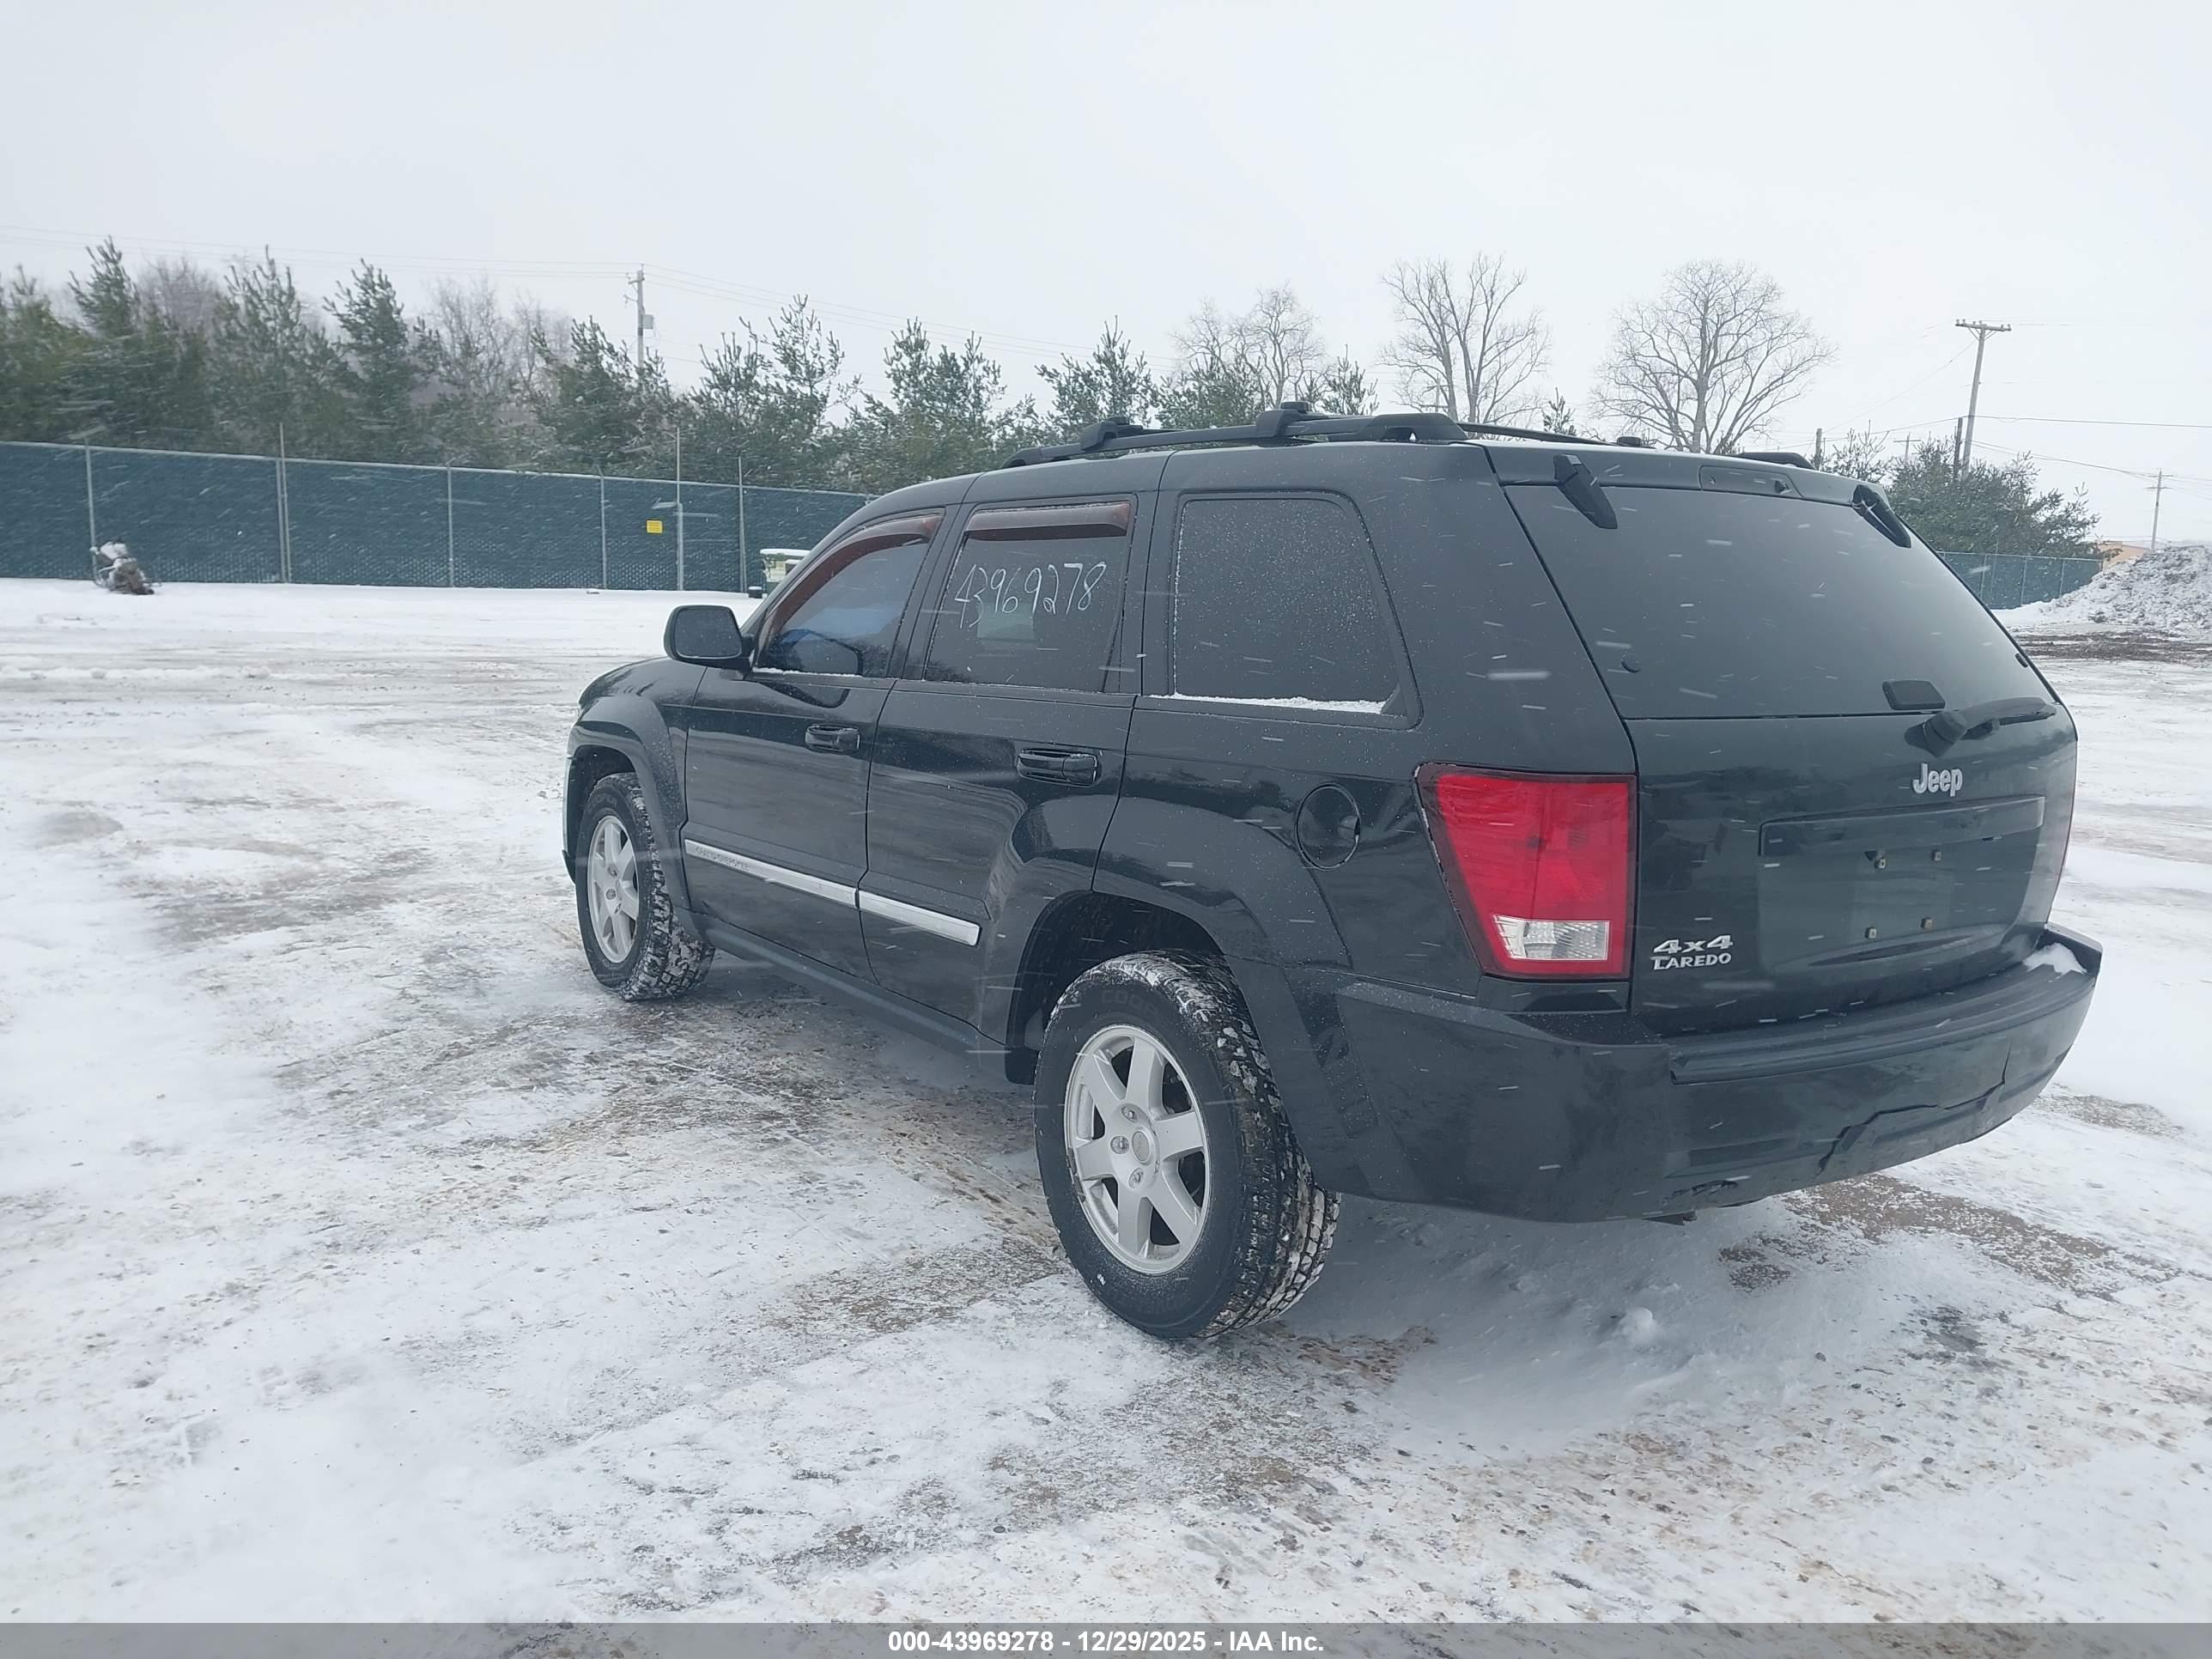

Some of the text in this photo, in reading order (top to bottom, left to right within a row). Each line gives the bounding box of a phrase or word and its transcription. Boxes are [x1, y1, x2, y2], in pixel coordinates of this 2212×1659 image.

[954, 561, 1107, 629] 43969278
[1911, 763, 1964, 797] Jeep
[1653, 934, 1734, 954] 4x4
[1653, 952, 1732, 970] LAREDO
